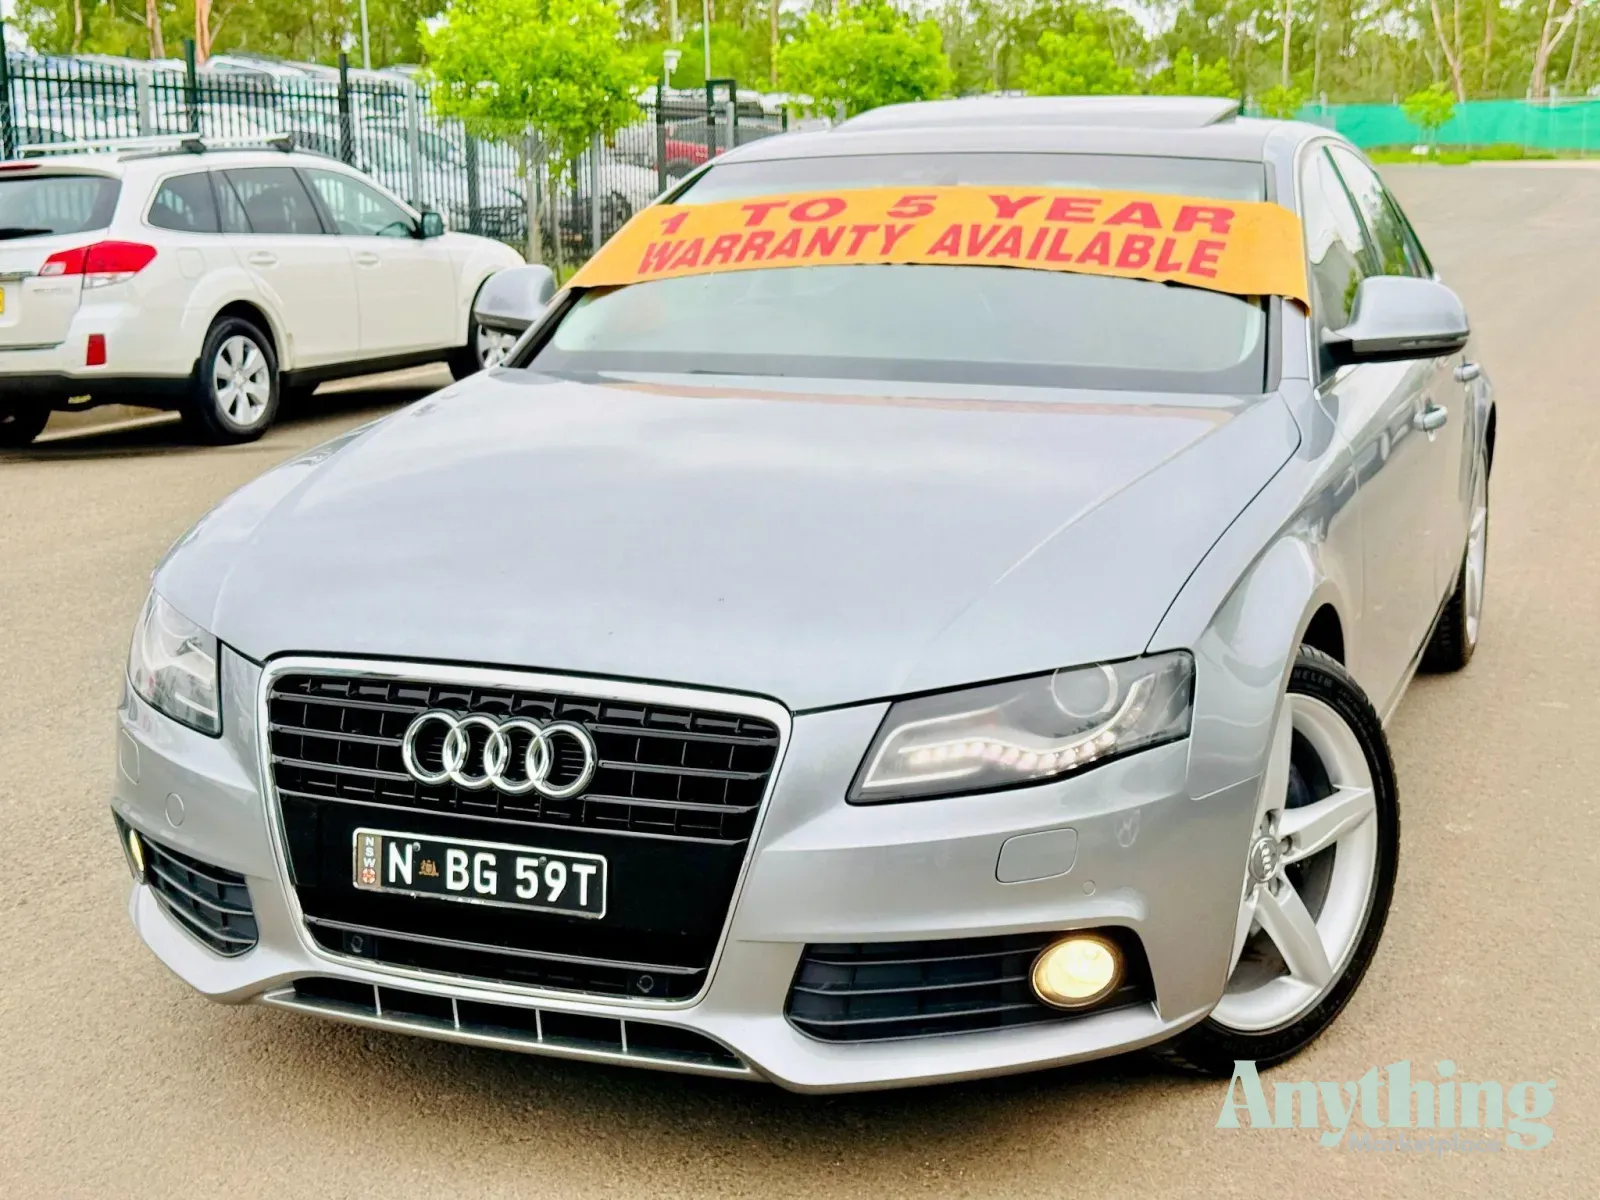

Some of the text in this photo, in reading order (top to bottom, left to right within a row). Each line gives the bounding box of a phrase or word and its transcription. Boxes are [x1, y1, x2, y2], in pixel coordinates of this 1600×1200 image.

[661, 195, 1236, 235] 1 TO 5 YEAR
[637, 224, 1227, 279] WARRANTY AVAILABLE
[363, 836, 377, 868] NSW
[388, 841, 597, 906] N BG 59T
